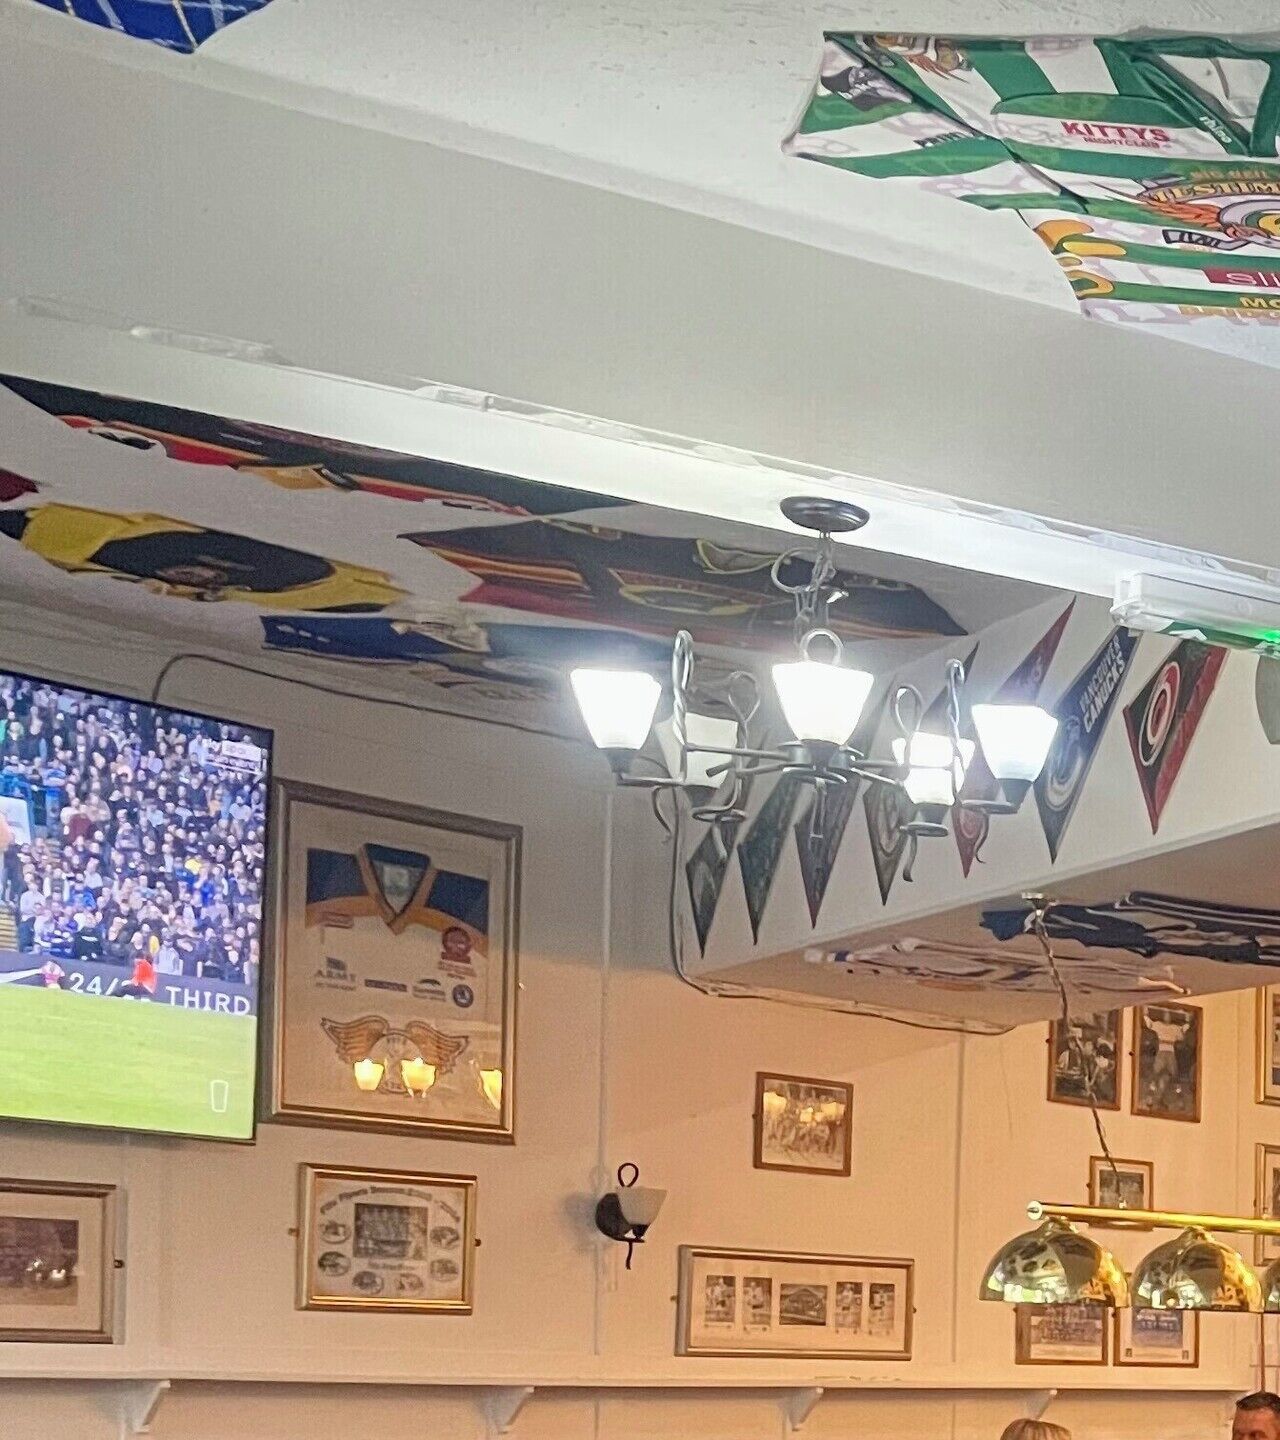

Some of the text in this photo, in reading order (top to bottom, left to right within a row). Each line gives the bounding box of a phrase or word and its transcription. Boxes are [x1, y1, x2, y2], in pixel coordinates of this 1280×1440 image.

[1060, 121, 1170, 142] KITTYS
[1079, 634, 1121, 712] VANCOUVER
[1084, 650, 1125, 733] CANUCKS
[166, 986, 250, 1015] THIRD
